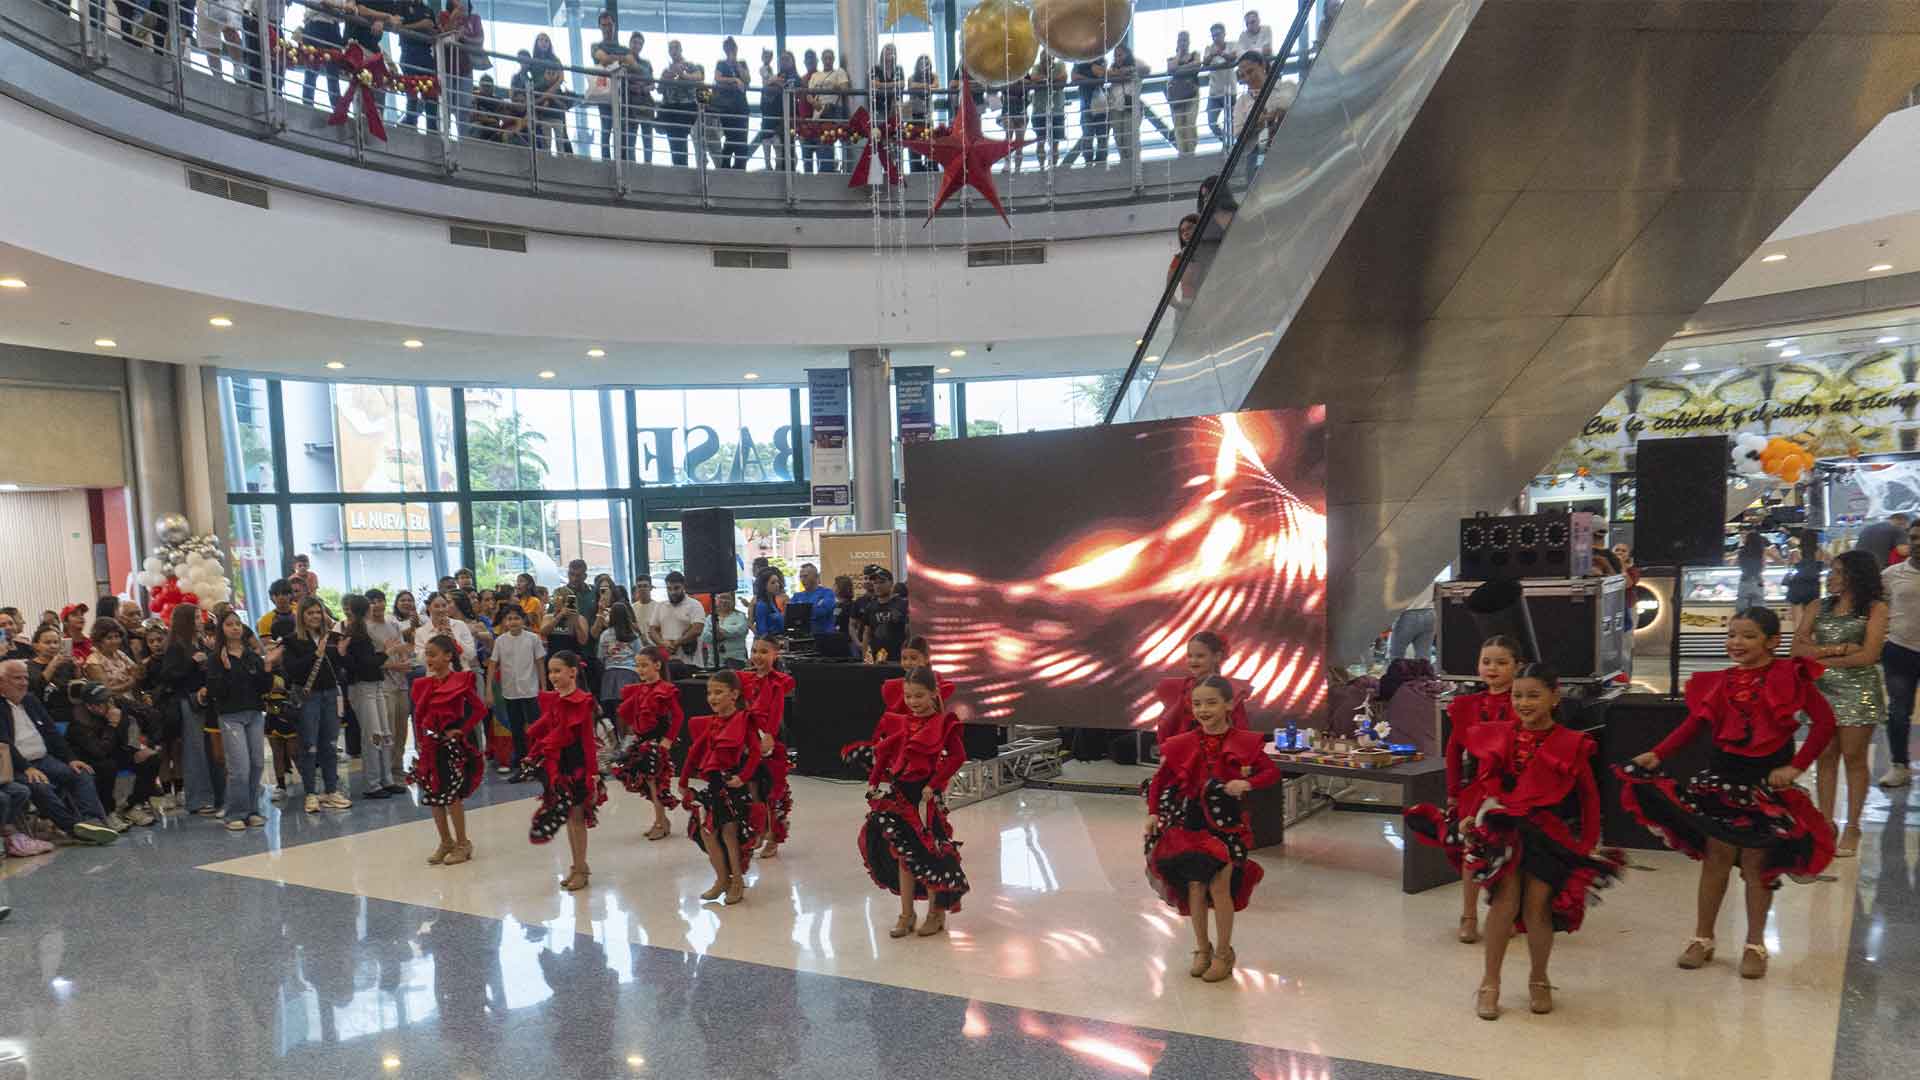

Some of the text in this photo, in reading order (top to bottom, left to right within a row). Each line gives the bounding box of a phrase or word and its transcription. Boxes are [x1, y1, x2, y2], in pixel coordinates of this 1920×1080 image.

[1584, 415, 1618, 436] Con
[1626, 415, 1647, 432] la
[1654, 406, 1728, 430] calidad
[1750, 402, 1769, 422] el
[1772, 394, 1824, 418] sabor
[1830, 394, 1854, 412] de
[352, 511, 367, 529] LA
